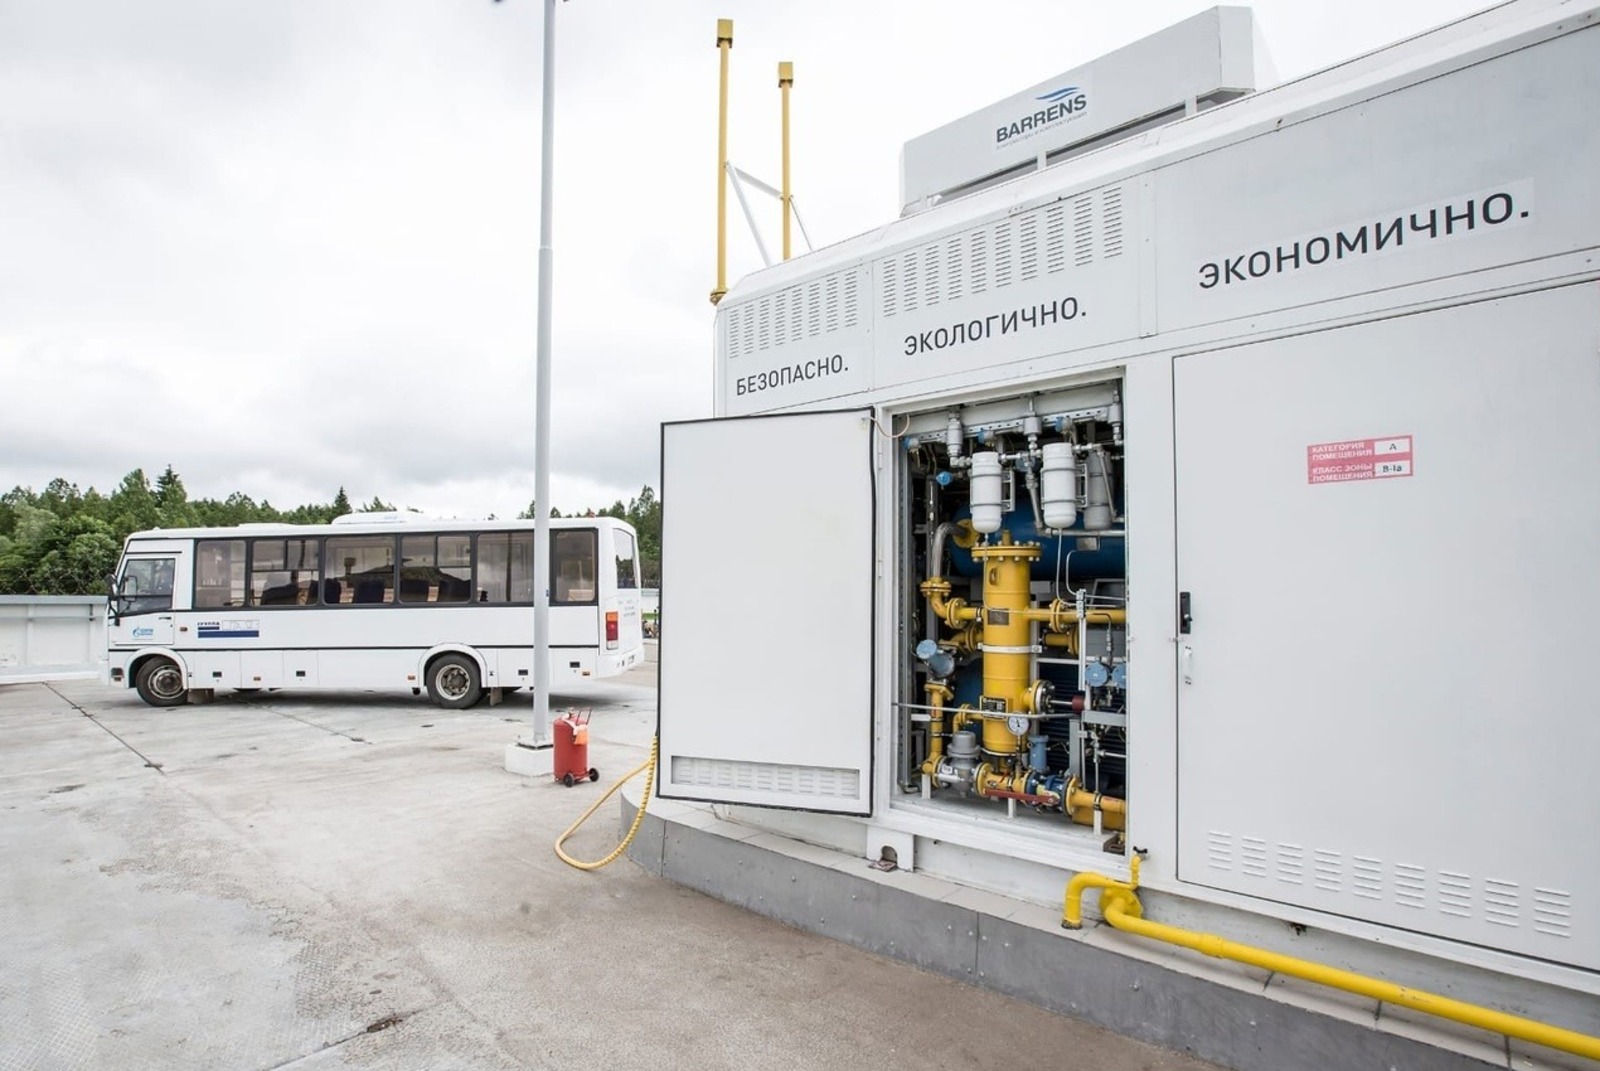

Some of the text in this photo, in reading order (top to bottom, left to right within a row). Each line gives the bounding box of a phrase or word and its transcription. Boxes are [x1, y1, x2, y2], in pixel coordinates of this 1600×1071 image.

[996, 94, 1087, 143] BARRENS
[1198, 192, 1529, 289] ЭКОНОМИЧНО.
[904, 296, 1087, 356] ЭКОЛОГИЧНО.
[736, 354, 849, 396] БЕЗОПАСНО.
[1312, 442, 1365, 453] КАТЕГОРИЯ
[1312, 449, 1373, 461] ПОМЕЩЕНИЯ
[1312, 463, 1373, 475] КЛАСС ЗОНЫ
[1313, 470, 1373, 482] ПОМЕЩЕНИЯ
